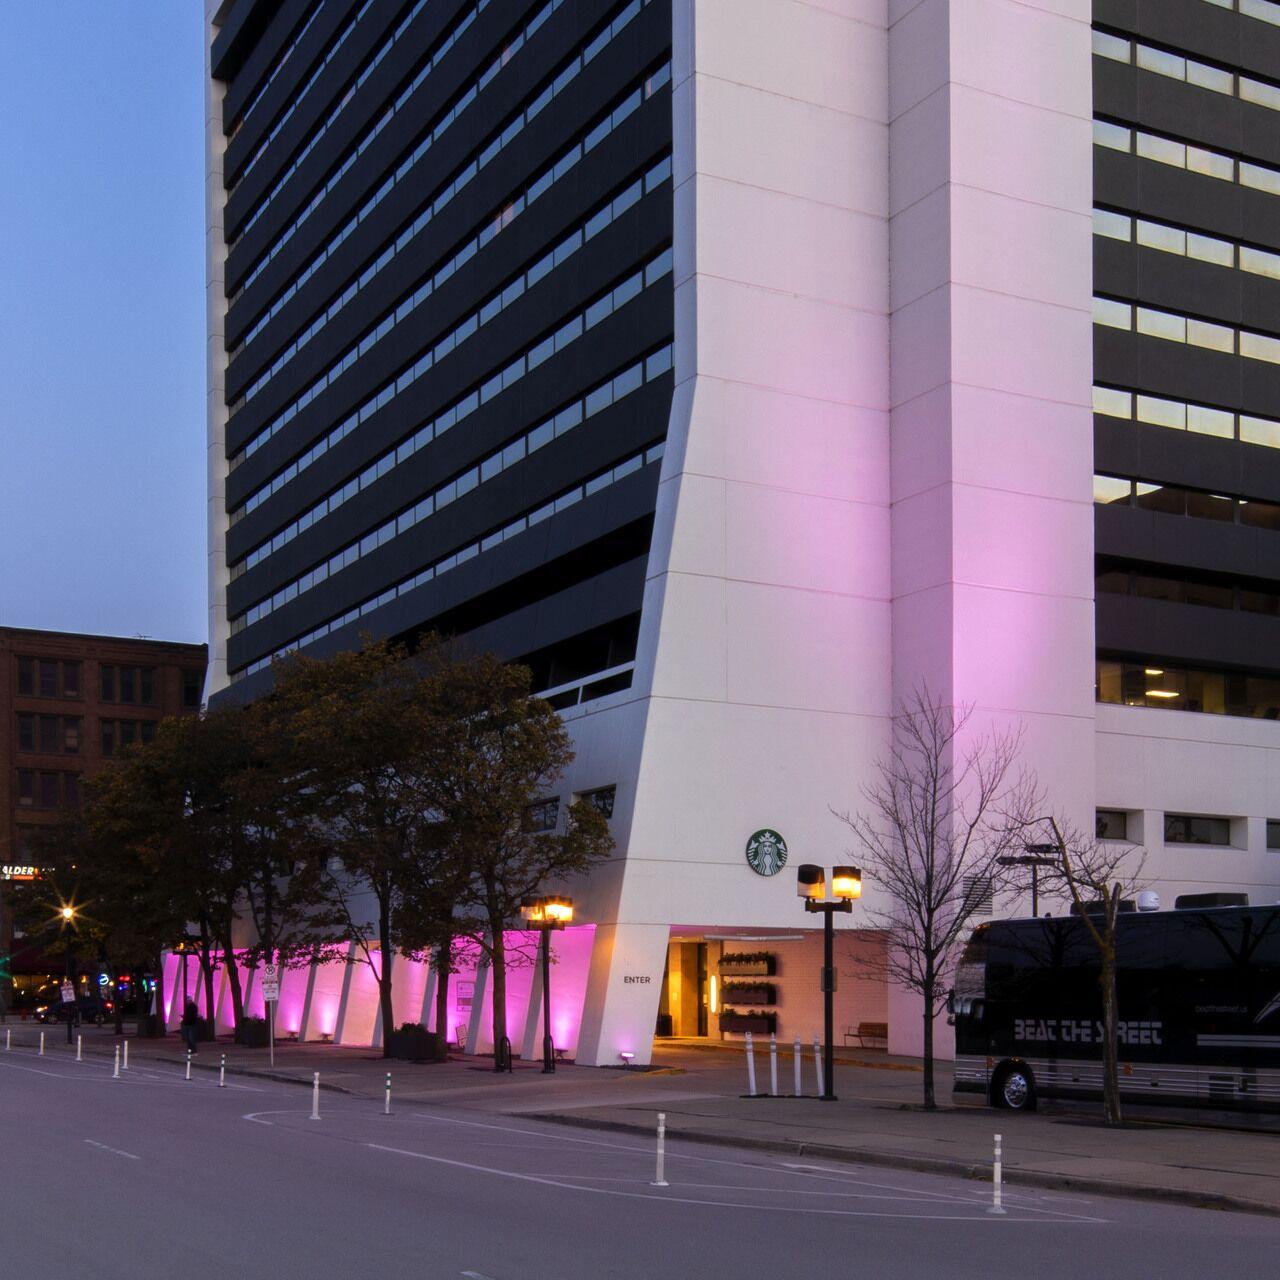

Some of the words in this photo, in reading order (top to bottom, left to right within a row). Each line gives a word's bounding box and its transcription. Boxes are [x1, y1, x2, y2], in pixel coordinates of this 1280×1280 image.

[623, 976, 651, 984] ENTER
[1014, 1018, 1058, 1041] BEAT
[1060, 1019, 1092, 1042] THE
[1095, 1020, 1163, 1045] SREET
